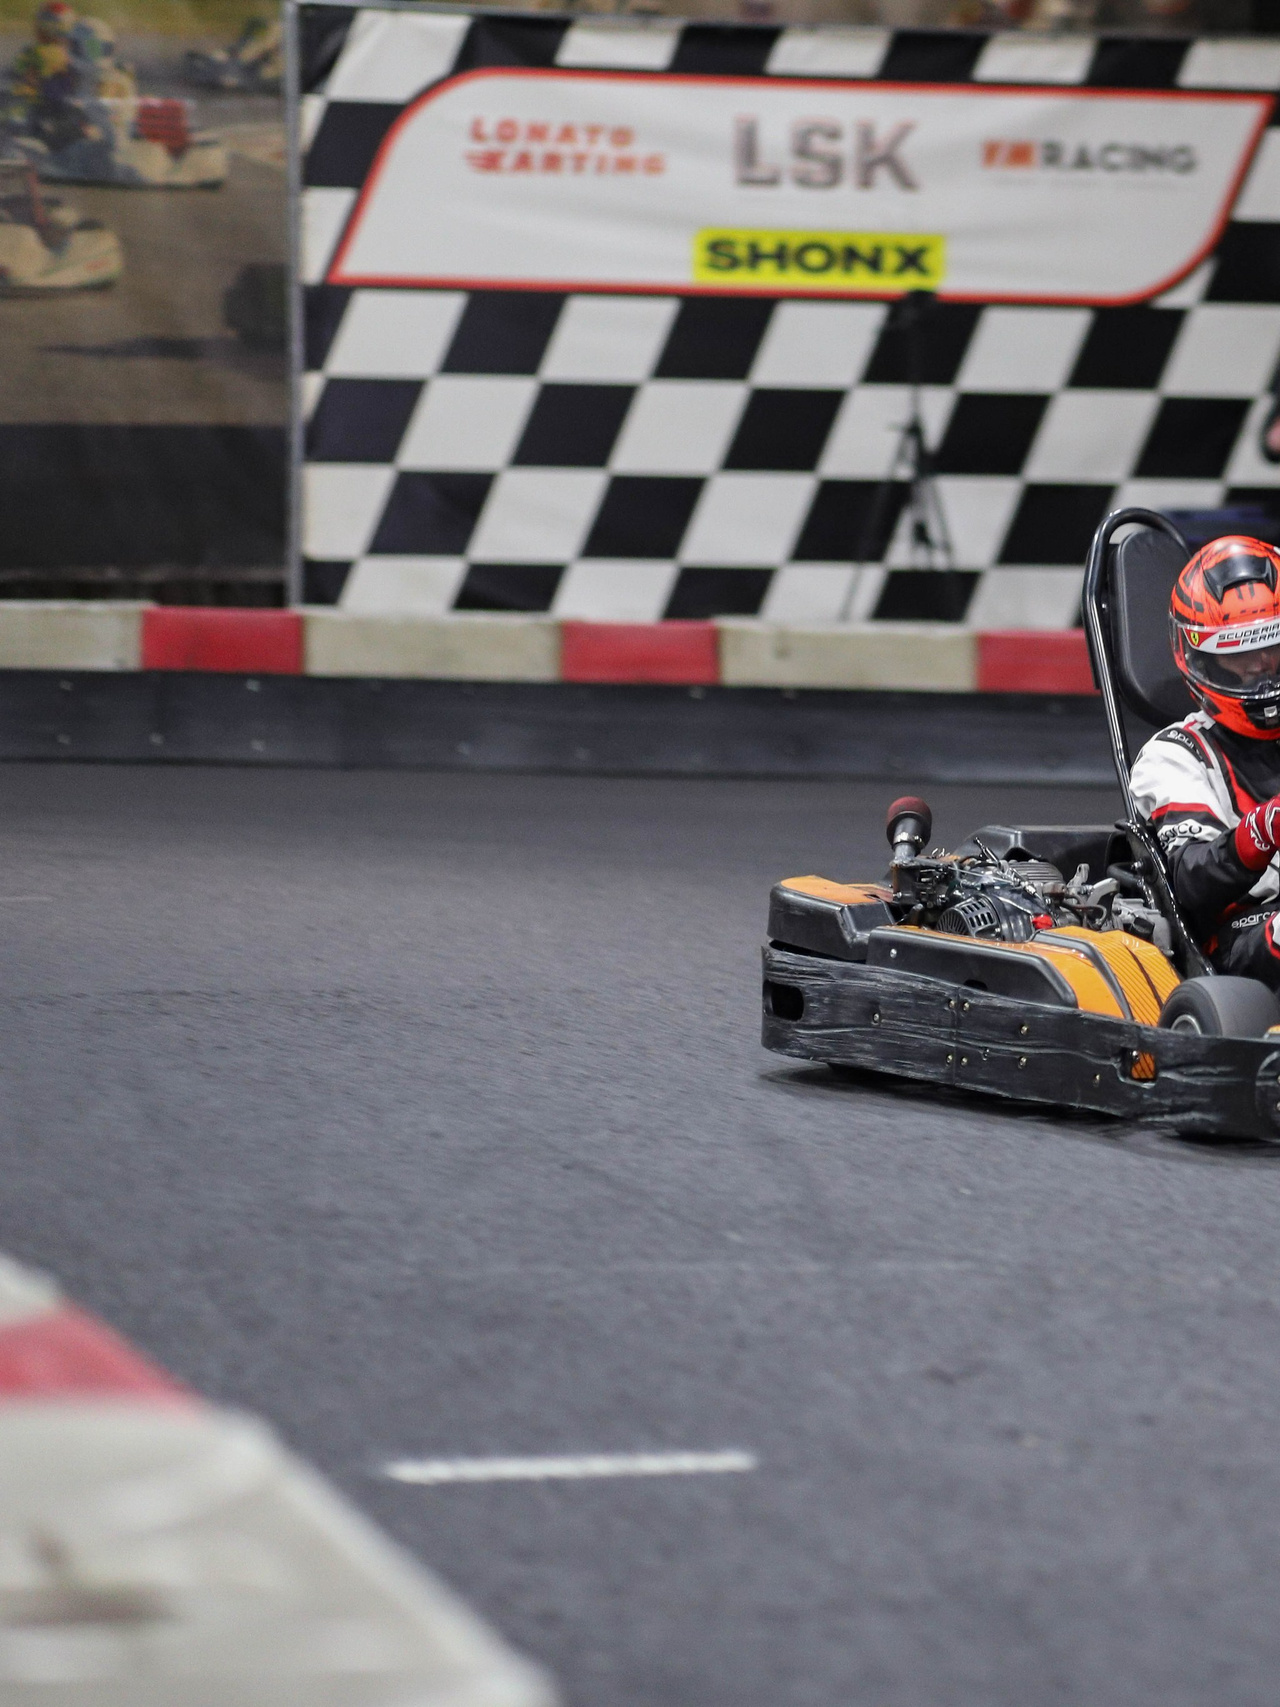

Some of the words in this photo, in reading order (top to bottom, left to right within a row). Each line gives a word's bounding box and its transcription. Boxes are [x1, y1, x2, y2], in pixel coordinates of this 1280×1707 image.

[733, 114, 919, 191] LSK
[706, 239, 931, 276] SHONX
[1218, 623, 1279, 640] SCUDERIA
